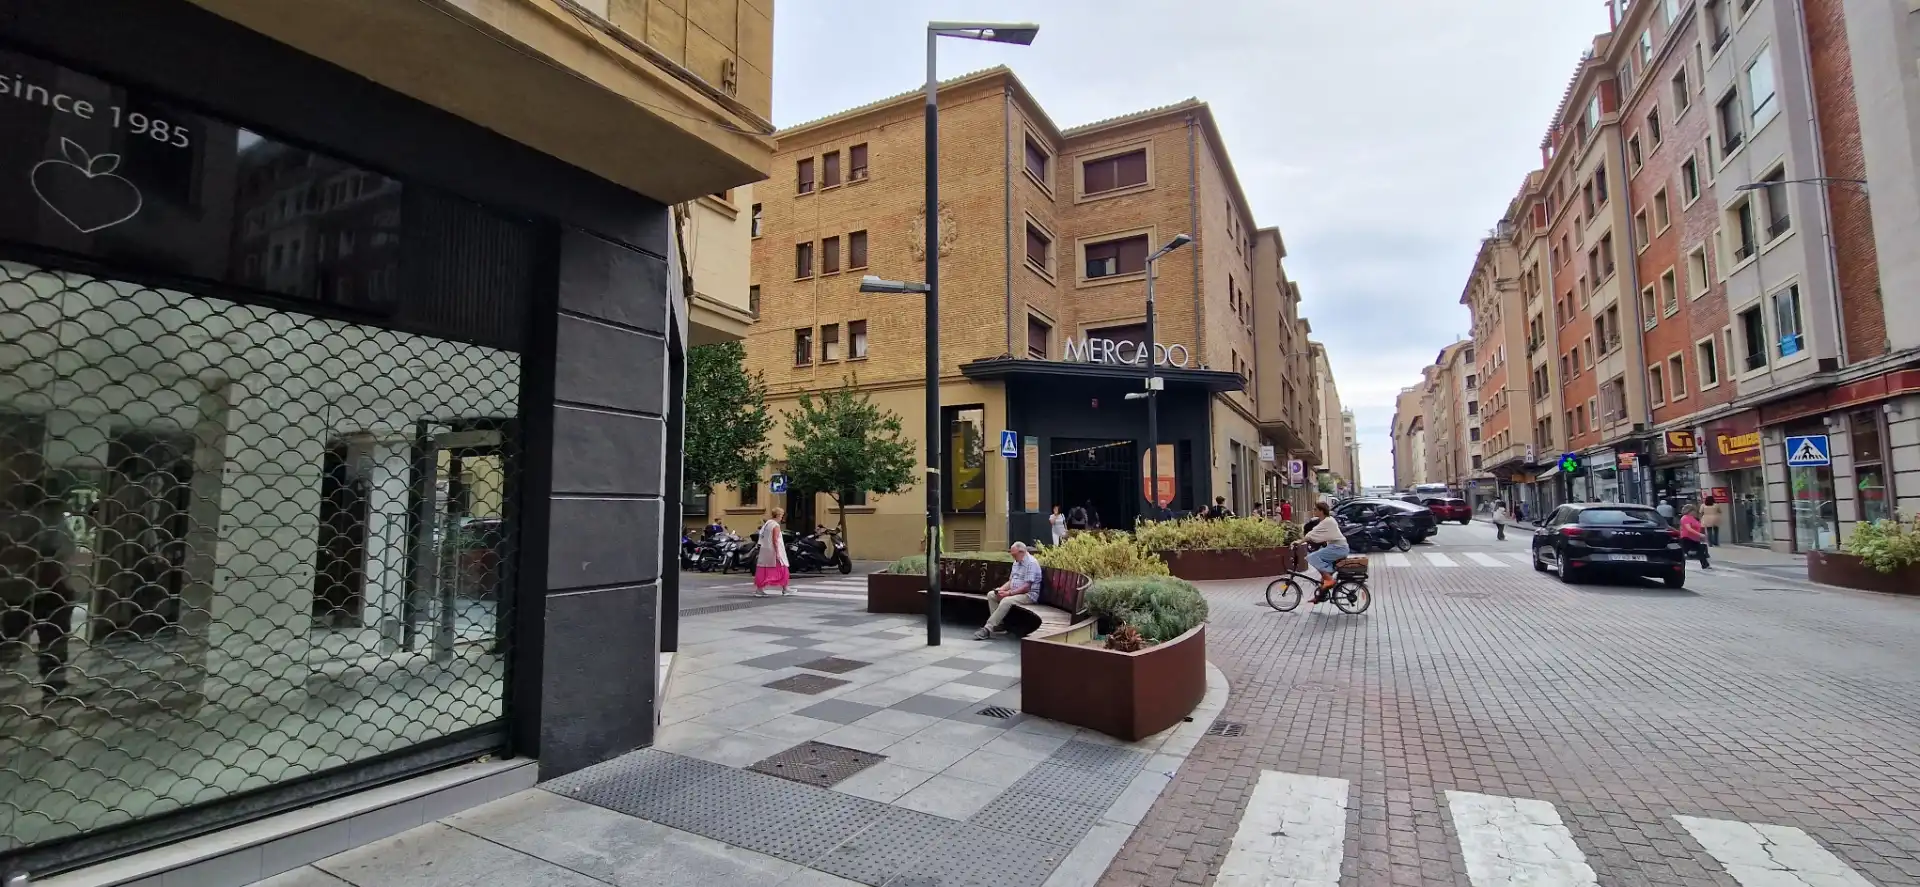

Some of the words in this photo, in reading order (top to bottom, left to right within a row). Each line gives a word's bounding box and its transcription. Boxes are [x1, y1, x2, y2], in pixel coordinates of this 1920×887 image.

[0, 74, 94, 119] since
[110, 106, 189, 148] 1985
[1063, 336, 1189, 368] MERCADO
